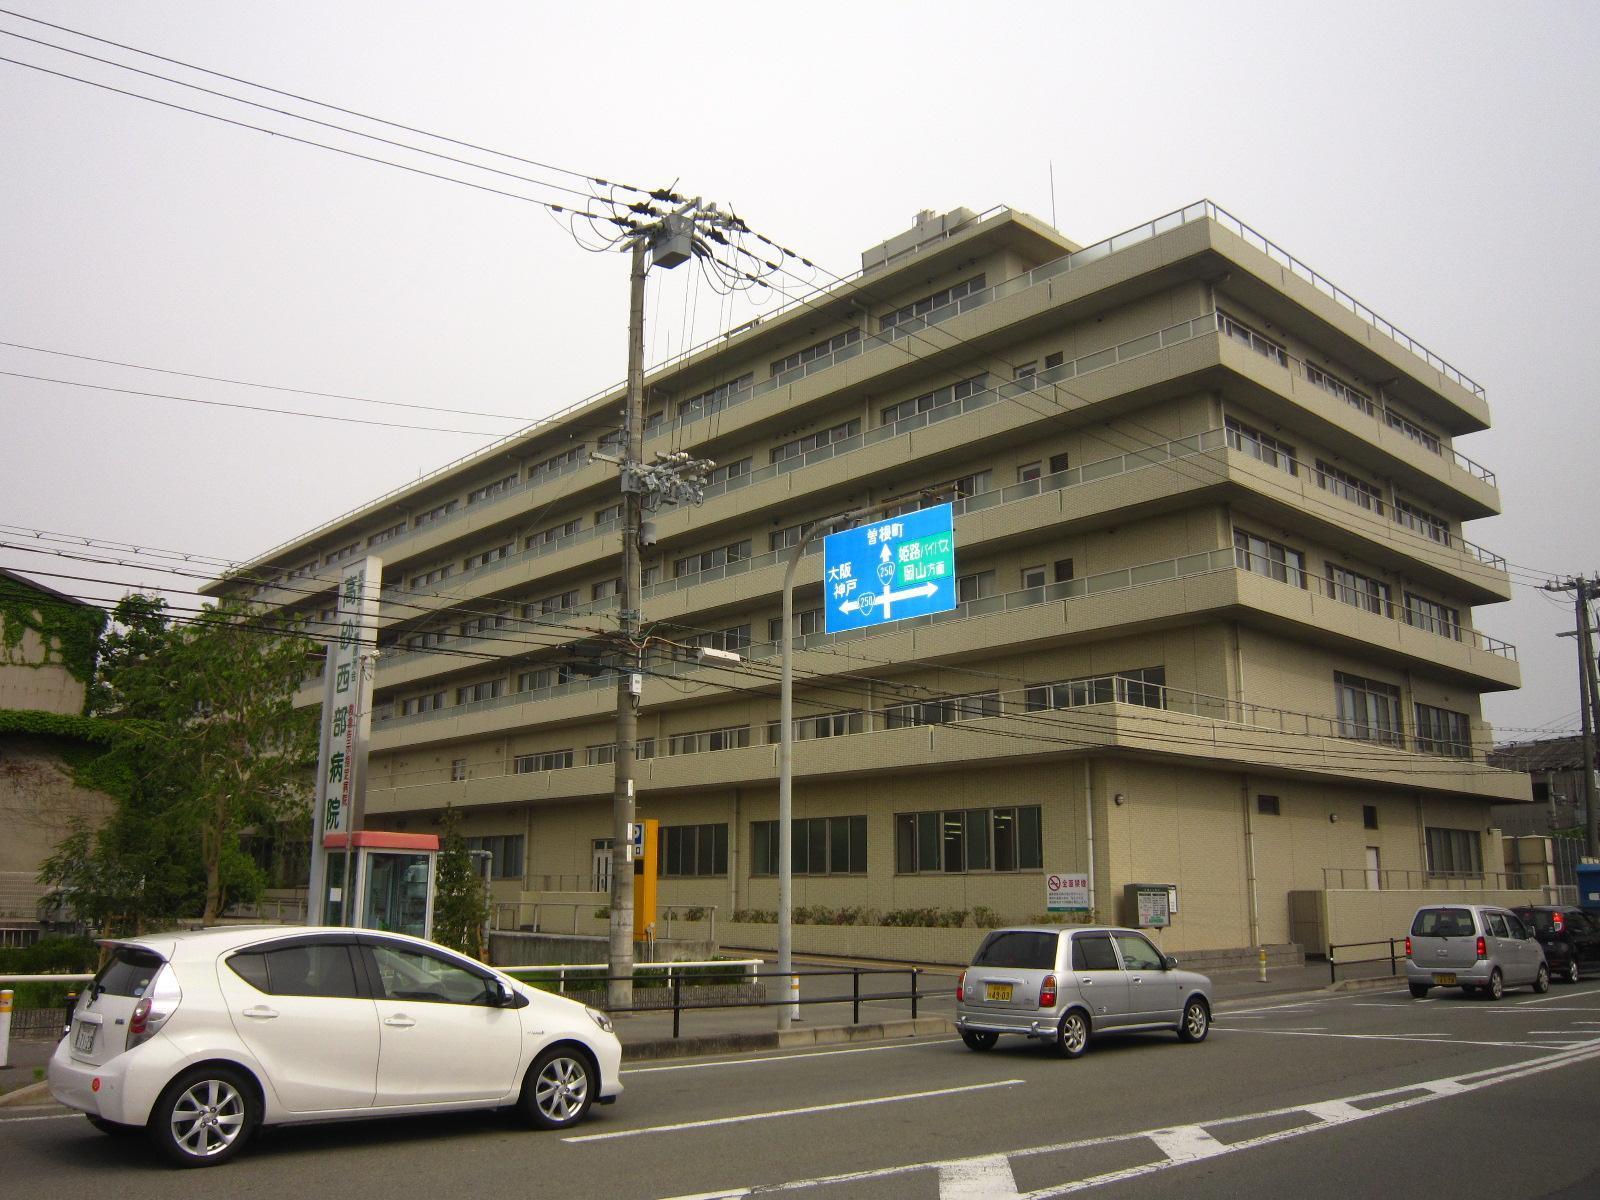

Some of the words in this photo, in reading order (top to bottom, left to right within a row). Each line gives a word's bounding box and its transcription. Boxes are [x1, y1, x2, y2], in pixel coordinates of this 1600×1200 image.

[867, 523, 904, 545] 曽根町
[899, 539, 949, 563] 姫路バイパス
[827, 562, 852, 582] 大阪
[880, 565, 893, 578] 250
[903, 561, 945, 582] 岡山方面
[833, 578, 858, 599] 神戸
[860, 596, 873, 608] 250
[326, 575, 357, 830] 高砂西部病院
